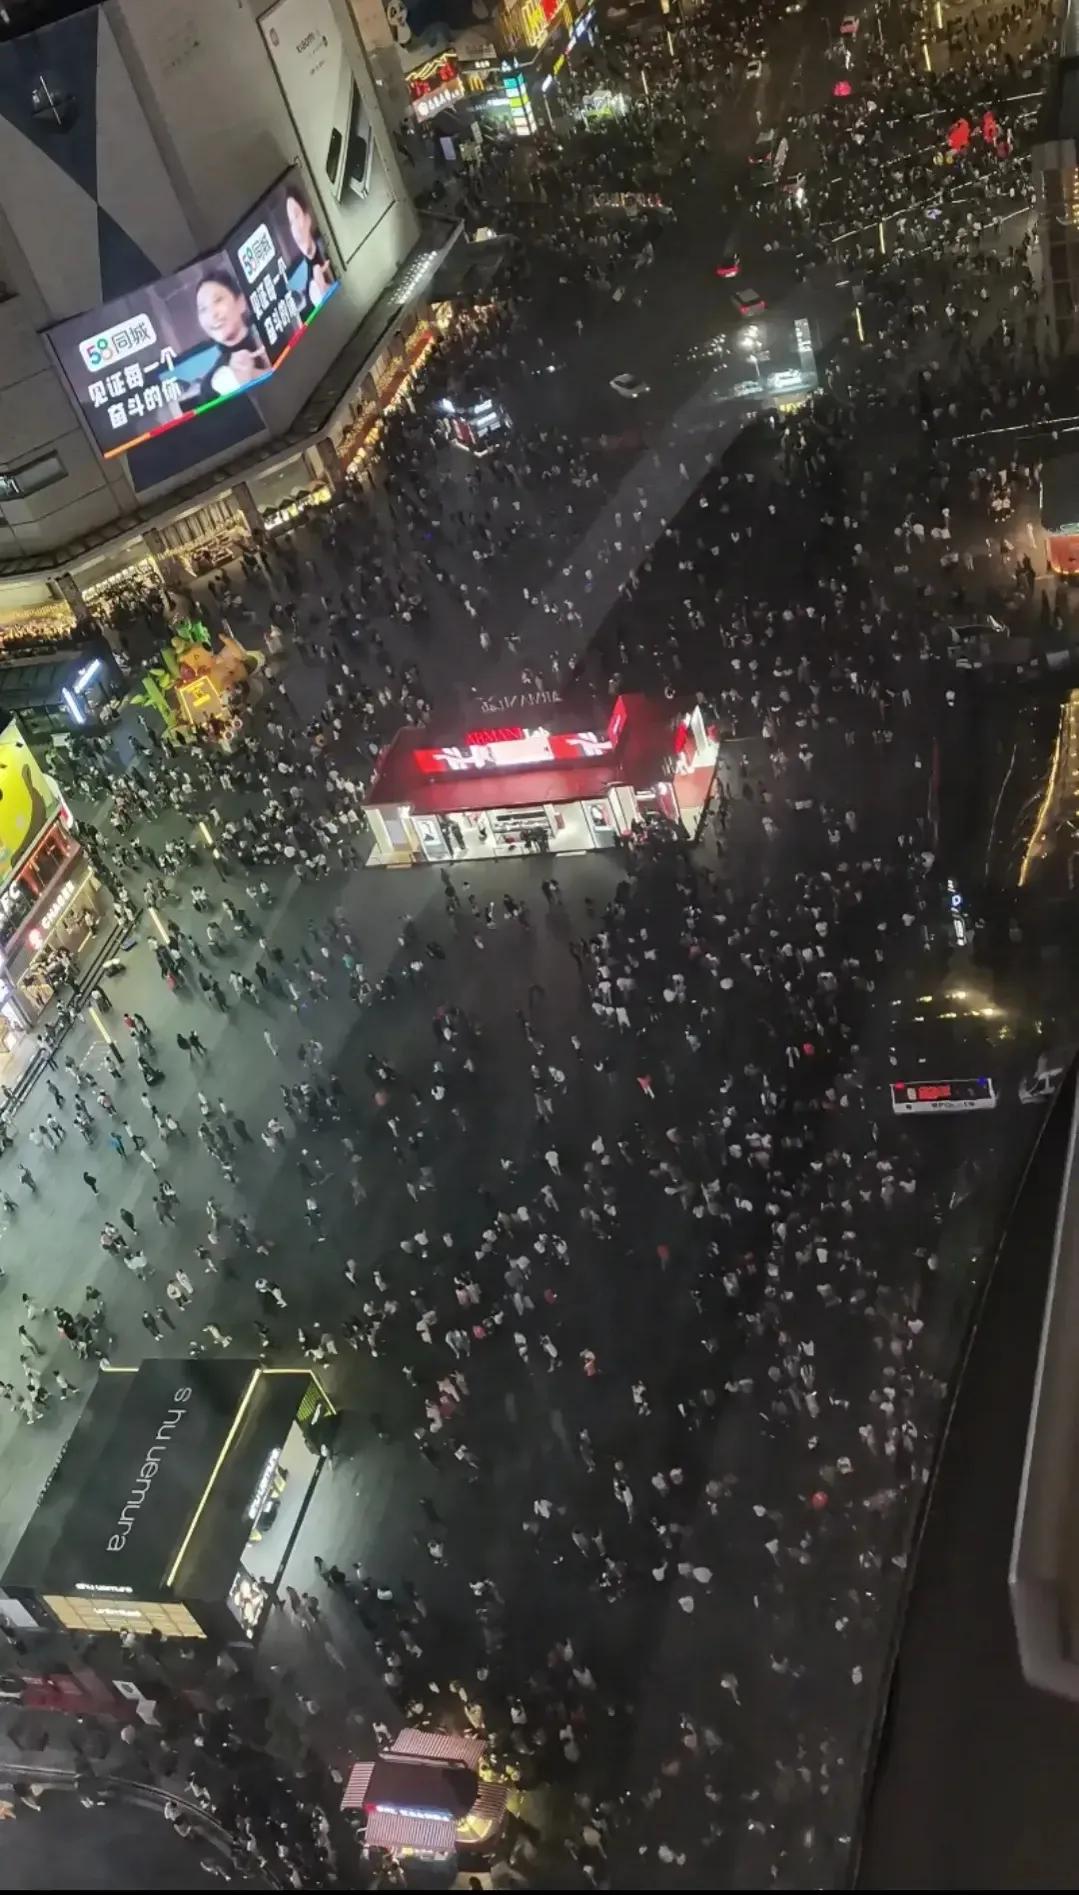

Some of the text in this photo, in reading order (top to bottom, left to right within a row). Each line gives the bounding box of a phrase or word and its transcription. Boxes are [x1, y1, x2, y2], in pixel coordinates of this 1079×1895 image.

[249, 256, 288, 320] 见证每一个
[86, 321, 151, 365] 58同城
[264, 290, 299, 345] 奋斗的你
[87, 346, 178, 408] 见证每一个
[107, 376, 181, 429] 奋斗的你
[106, 1387, 192, 1551] shu uemura
